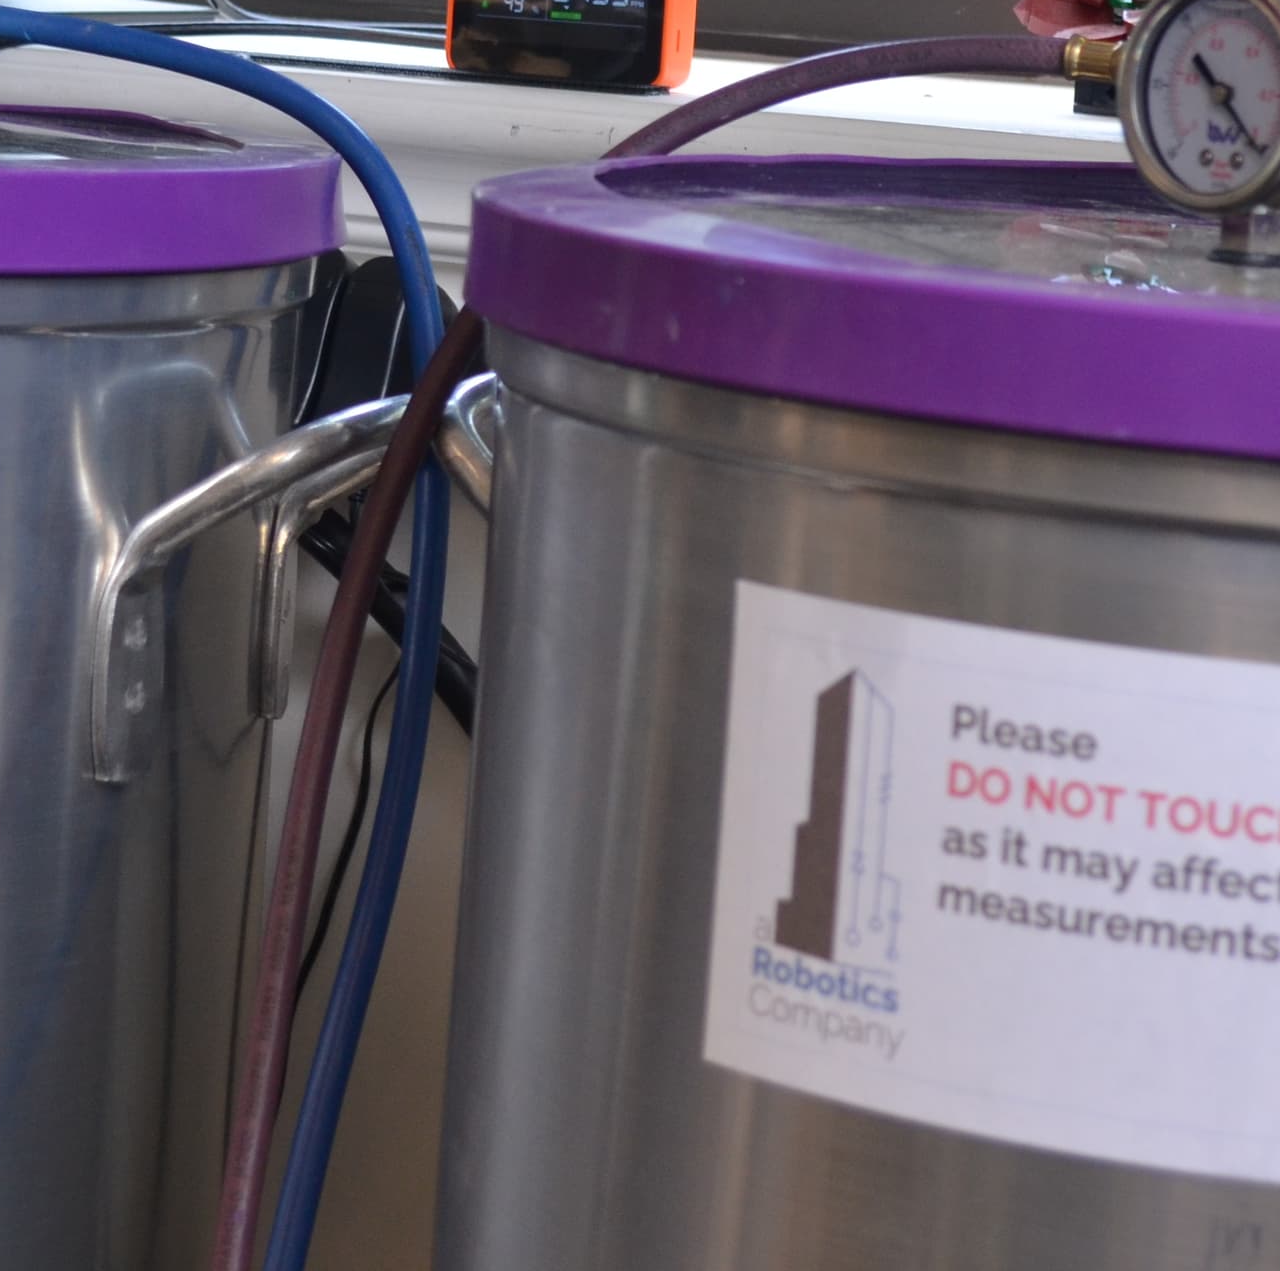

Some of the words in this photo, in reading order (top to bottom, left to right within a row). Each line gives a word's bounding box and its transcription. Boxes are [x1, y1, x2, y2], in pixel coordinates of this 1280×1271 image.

[951, 703, 1098, 761] Please
[946, 761, 1013, 805] DO
[1024, 774, 1126, 824] NOT
[941, 824, 989, 861] as
[1001, 829, 1029, 868] it
[1041, 844, 1141, 895] may
[753, 915, 773, 944] a
[750, 945, 901, 1015] Robotics
[746, 984, 906, 1062] Company
